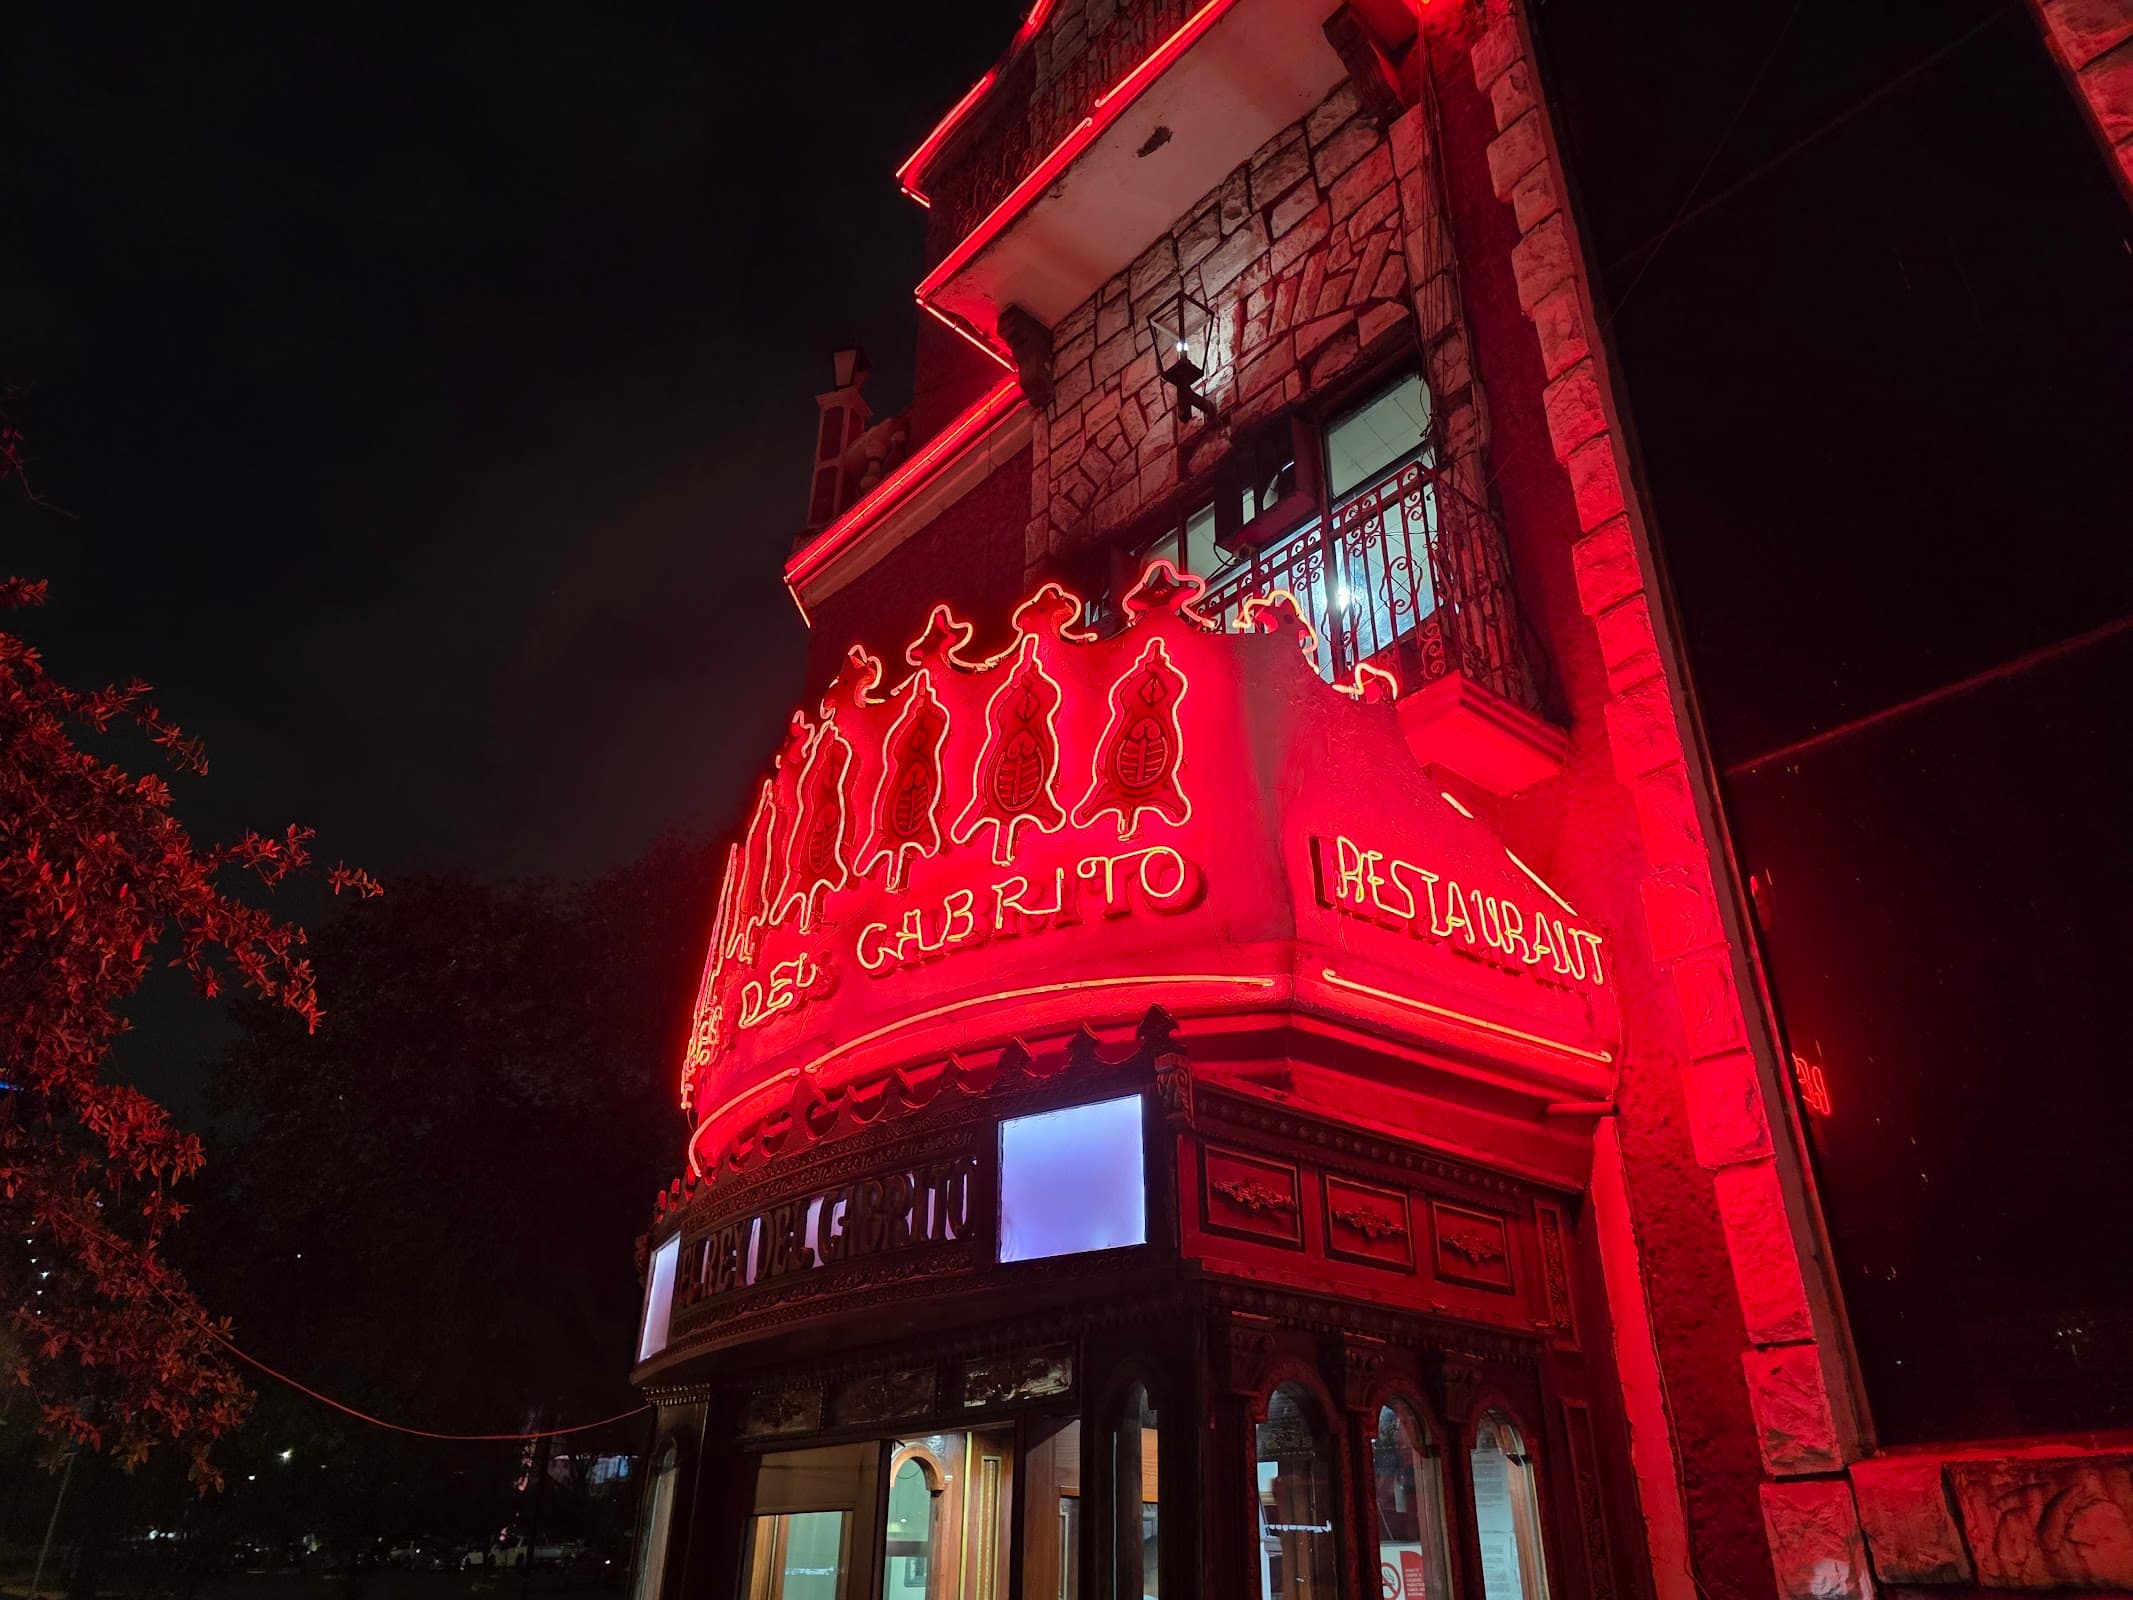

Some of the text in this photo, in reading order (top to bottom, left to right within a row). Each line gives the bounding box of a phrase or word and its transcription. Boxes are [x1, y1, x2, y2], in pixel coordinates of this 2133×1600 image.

[738, 845, 1186, 1030] DEL CABRITO
[1335, 835, 1604, 985] RESTAURANT
[702, 1222, 754, 1300] REY
[754, 1198, 816, 1281] DEL
[817, 1158, 977, 1267] CABRITO
